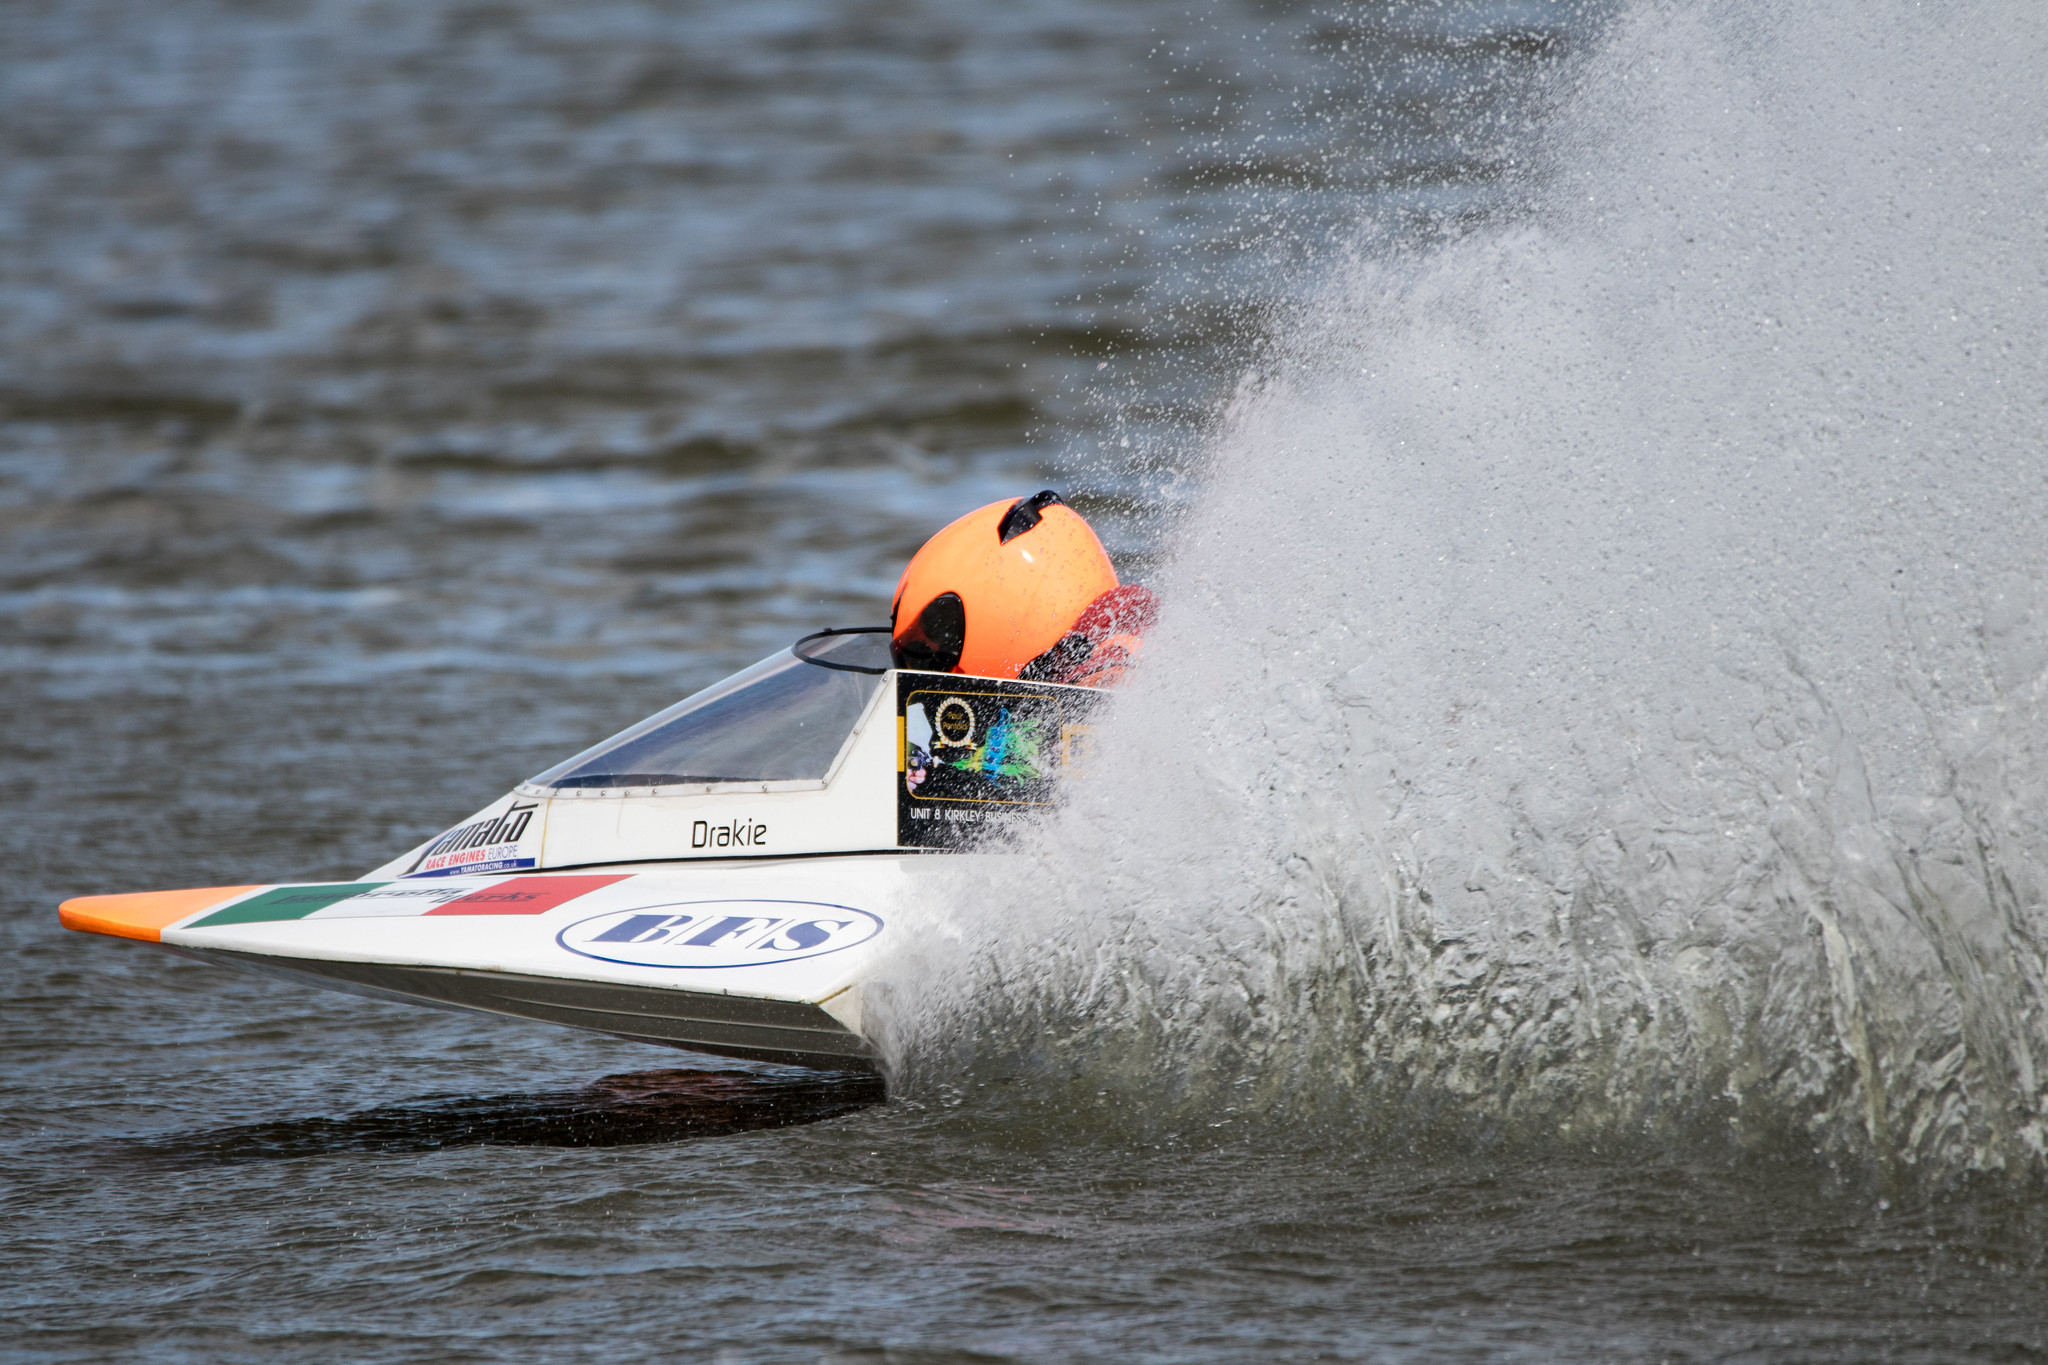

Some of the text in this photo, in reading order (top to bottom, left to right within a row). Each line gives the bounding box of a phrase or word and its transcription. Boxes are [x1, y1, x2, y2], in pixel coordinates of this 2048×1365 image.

[910, 807, 931, 820] UNIT
[934, 809, 941, 820] 8
[945, 808, 980, 823] KIRKLEY
[691, 818, 767, 849] Drakie
[424, 844, 518, 871] RACE ENGINES EUROPE
